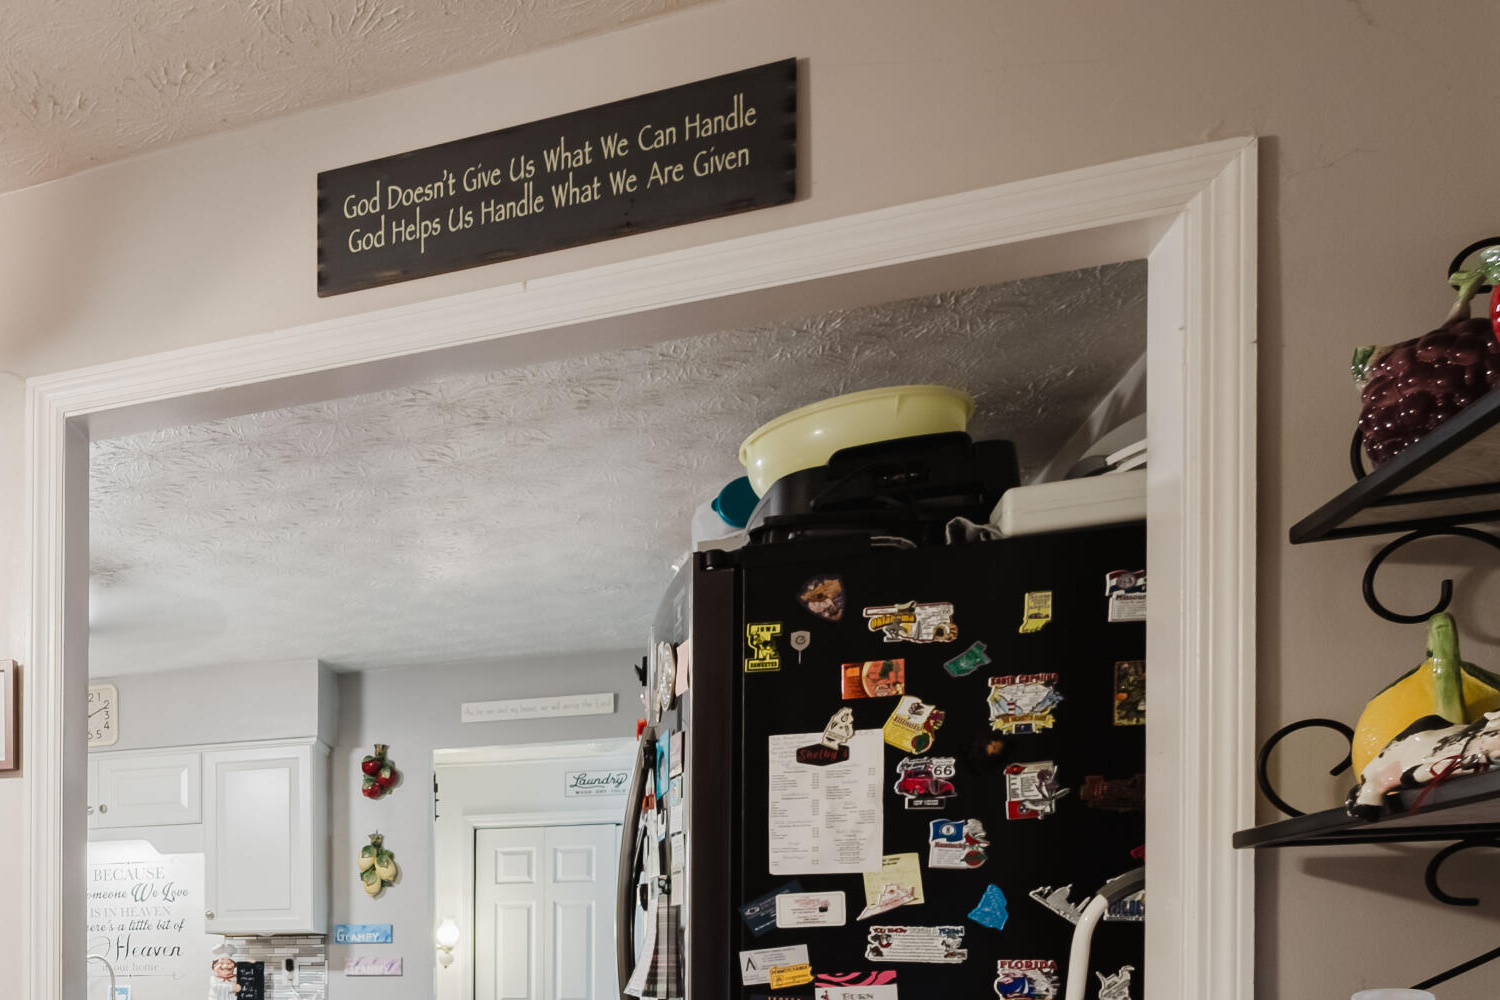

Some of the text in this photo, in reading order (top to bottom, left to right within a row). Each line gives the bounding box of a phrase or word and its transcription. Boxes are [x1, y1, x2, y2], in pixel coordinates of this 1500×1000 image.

[343, 92, 757, 220] God Doesn't Give Us What We Can Handle
[348, 146, 750, 254] God Helps Us Handle What We Are Given
[103, 700, 110, 709] 2
[104, 710, 110, 720] 3
[103, 720, 110, 730] 4
[96, 729, 102, 739] 5
[934, 766, 952, 776] 66
[569, 772, 628, 789] Laundry
[93, 866, 165, 882] BECAUSE
[87, 881, 189, 903] omeone We Love
[90, 906, 172, 918] IS IN HEAVEN
[87, 920, 114, 932] ere's
[128, 919, 152, 931] little
[156, 919, 171, 931] bit
[173, 918, 186, 932] of
[115, 934, 181, 962] Heaven
[999, 959, 1057, 970] FLORIDA
